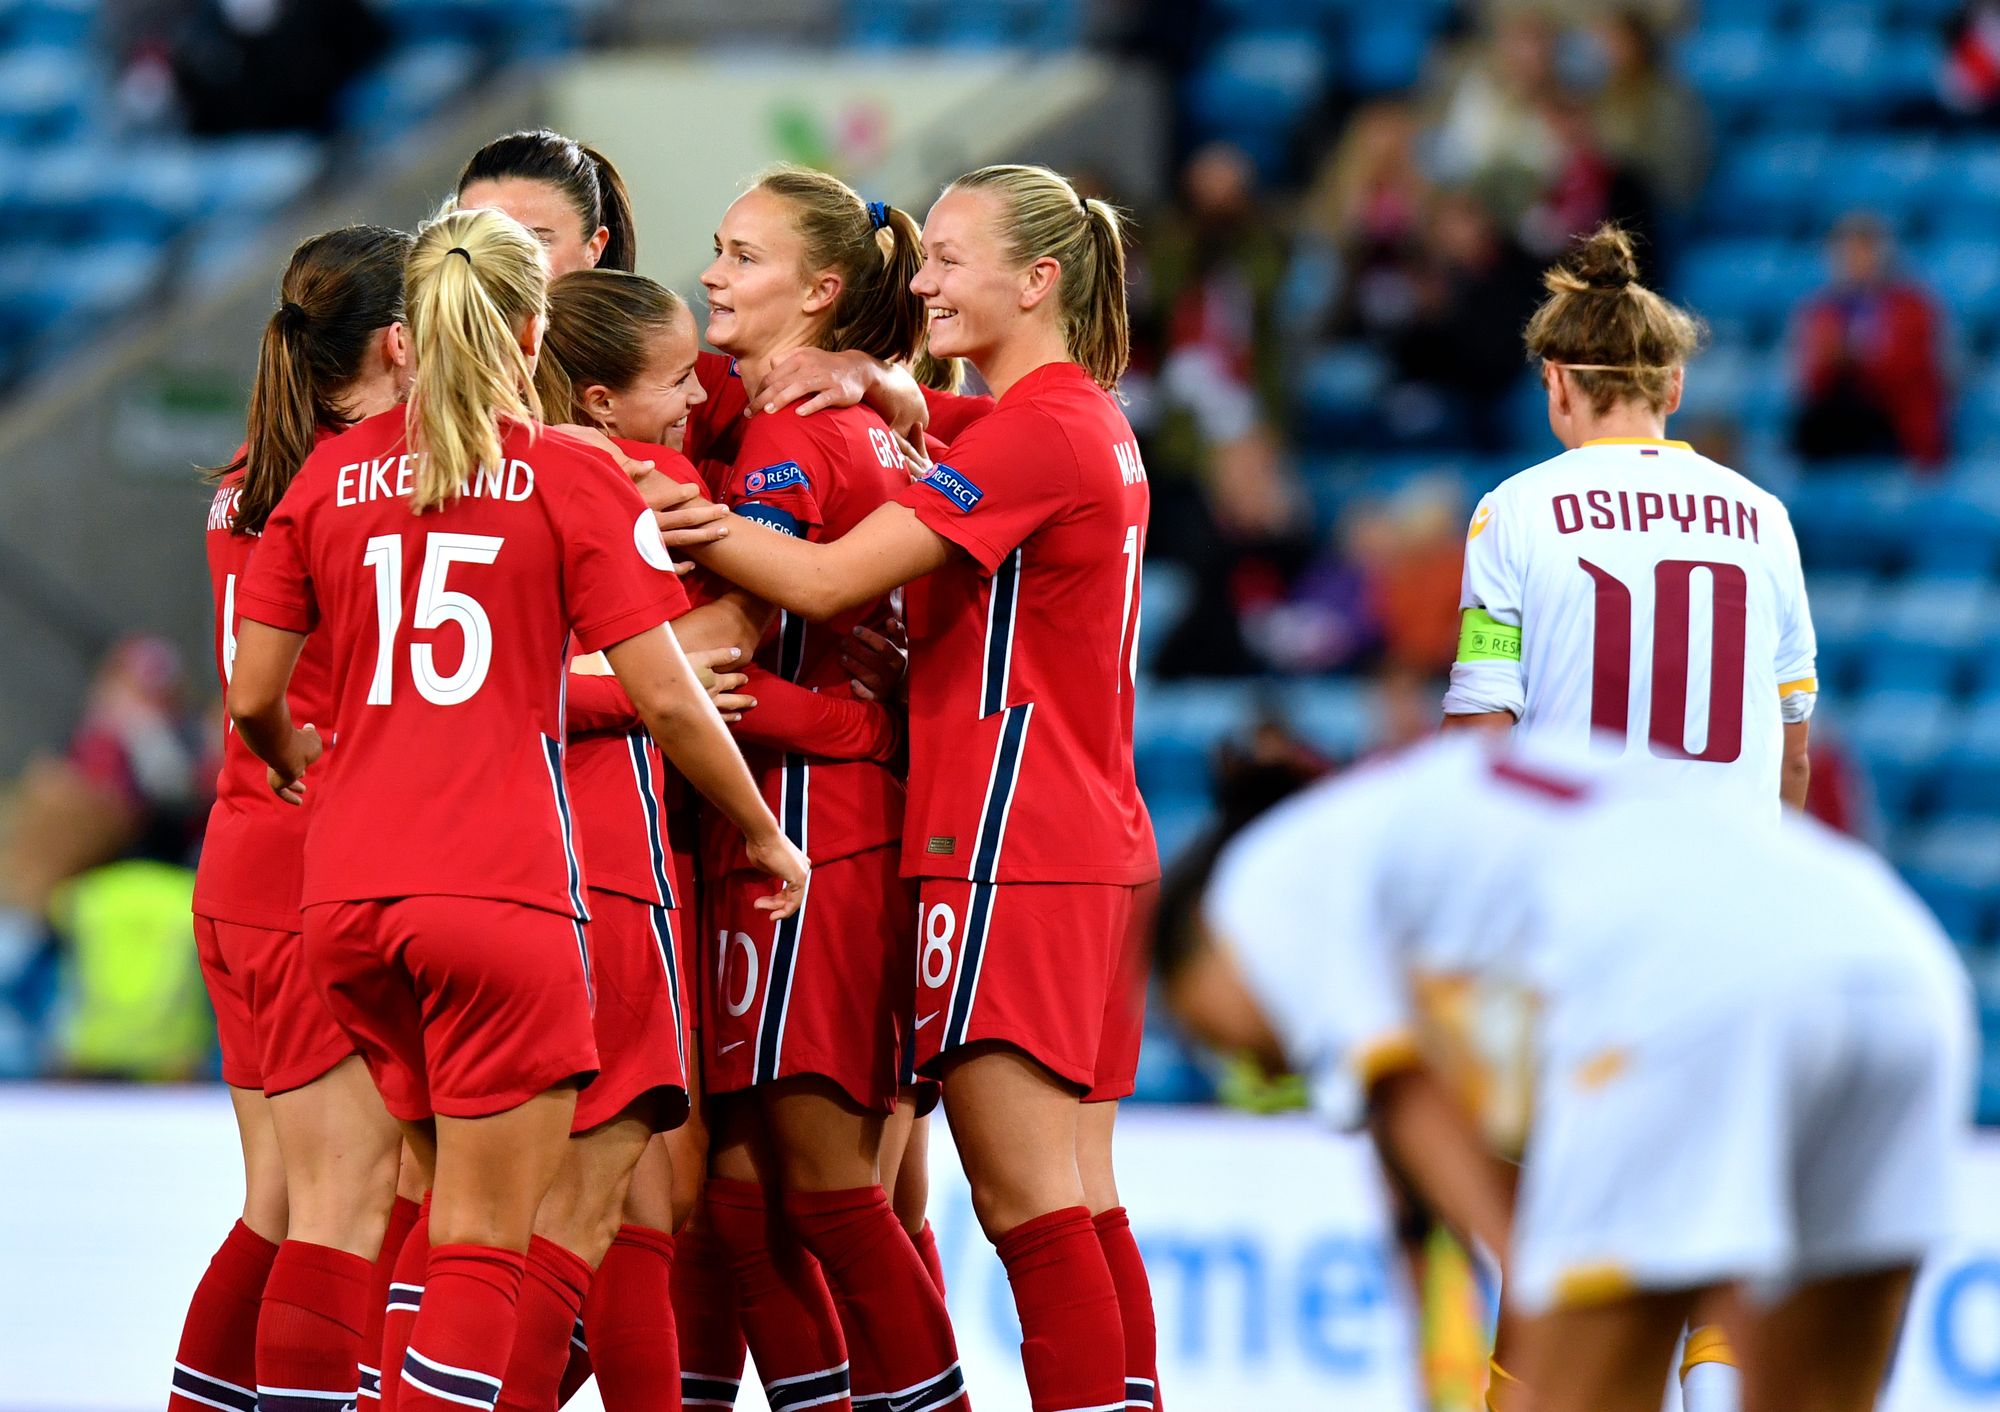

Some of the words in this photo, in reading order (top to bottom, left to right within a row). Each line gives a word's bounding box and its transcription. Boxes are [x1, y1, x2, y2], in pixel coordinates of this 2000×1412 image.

[931, 470, 979, 506] RESPECT
[1551, 489, 1760, 545] OSIPYAN
[362, 531, 506, 707] 15
[1577, 556, 1747, 764] 10
[717, 929, 759, 1017] 10
